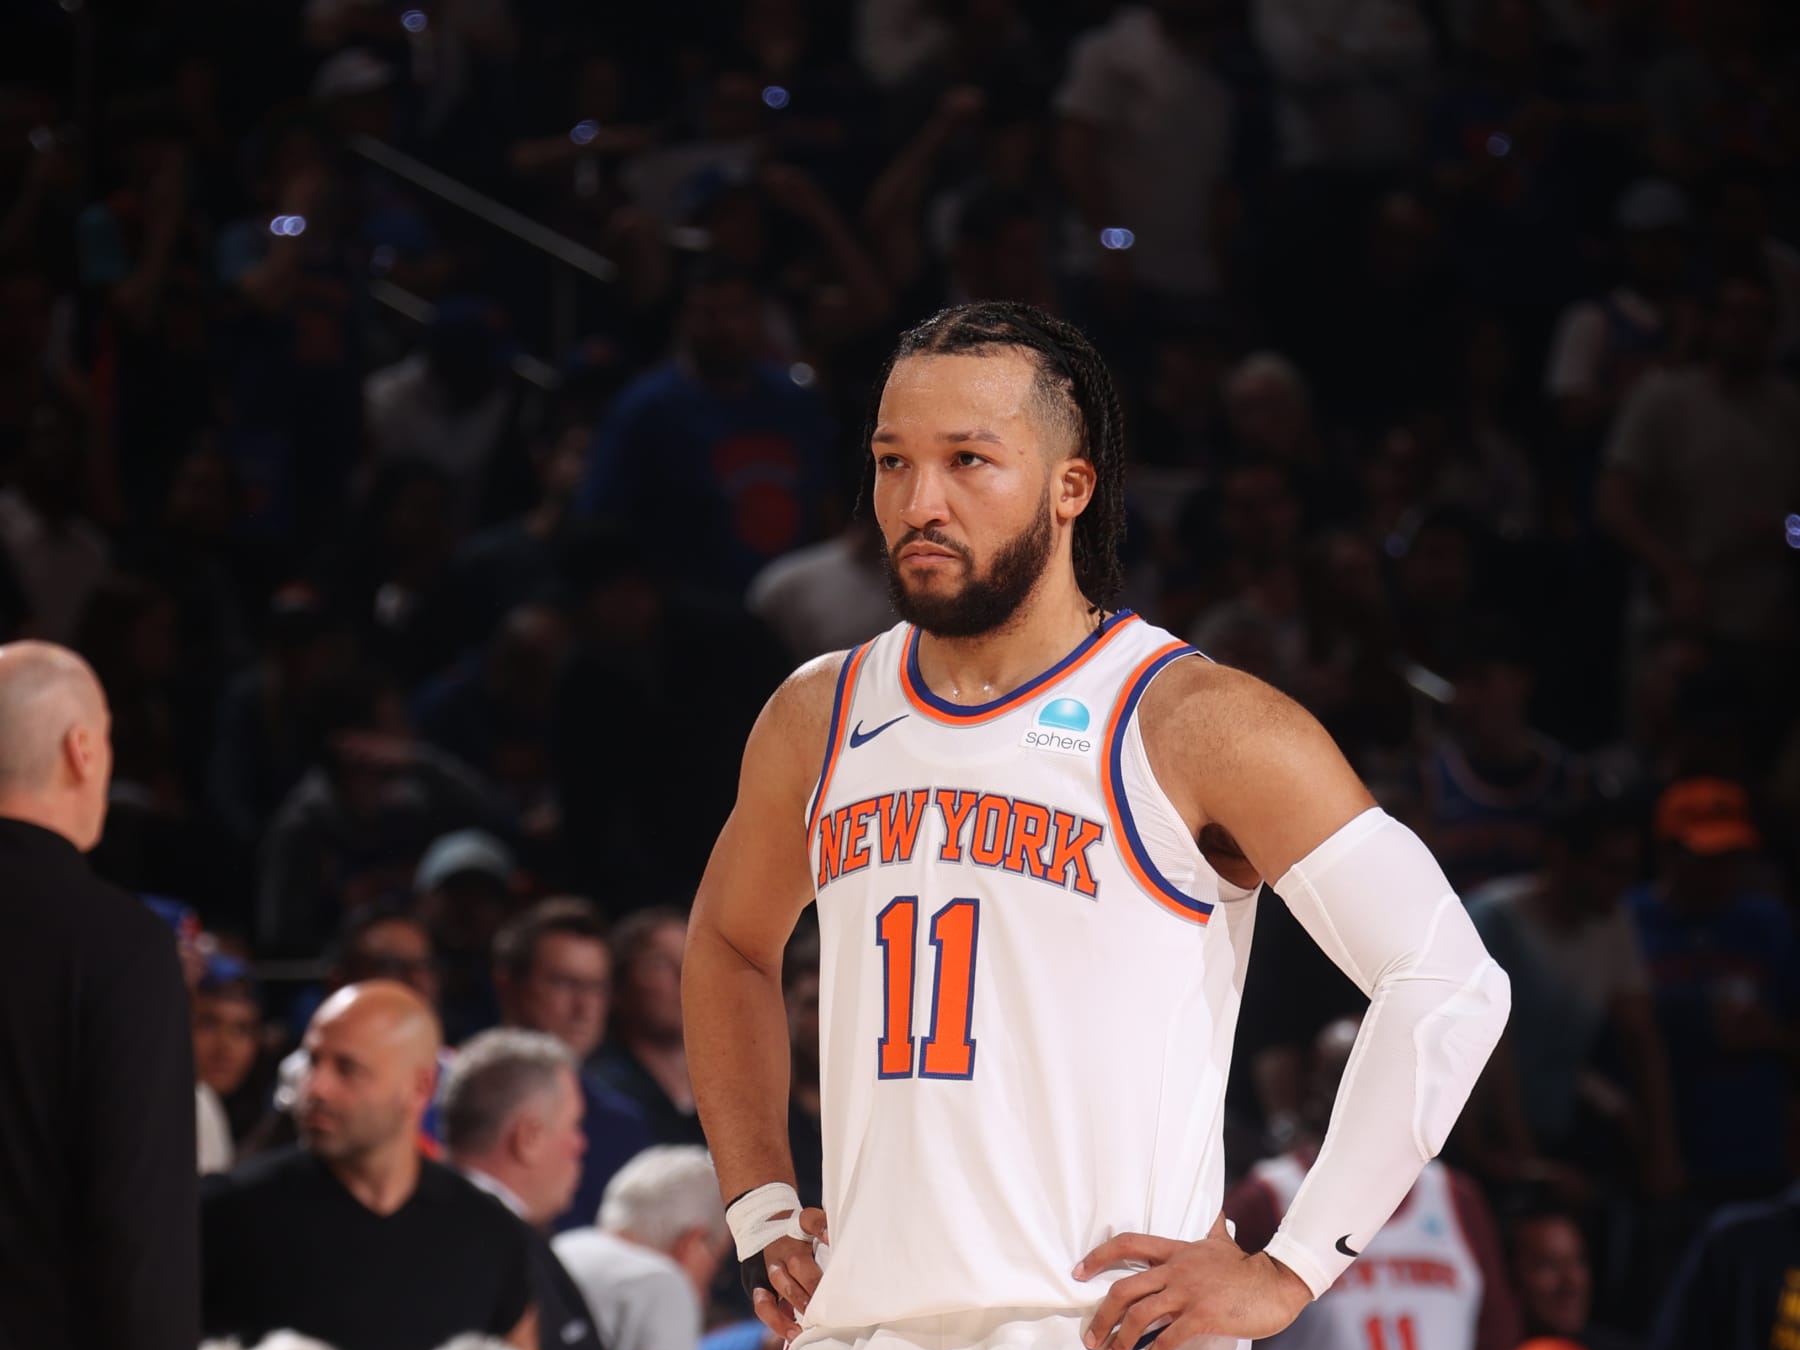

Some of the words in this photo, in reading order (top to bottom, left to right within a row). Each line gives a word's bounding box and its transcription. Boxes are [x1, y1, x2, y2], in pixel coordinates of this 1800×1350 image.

[1025, 731, 1091, 752] sphere
[817, 788, 930, 889] NEW
[936, 787, 1105, 900] YORK
[876, 895, 980, 1081] 11
